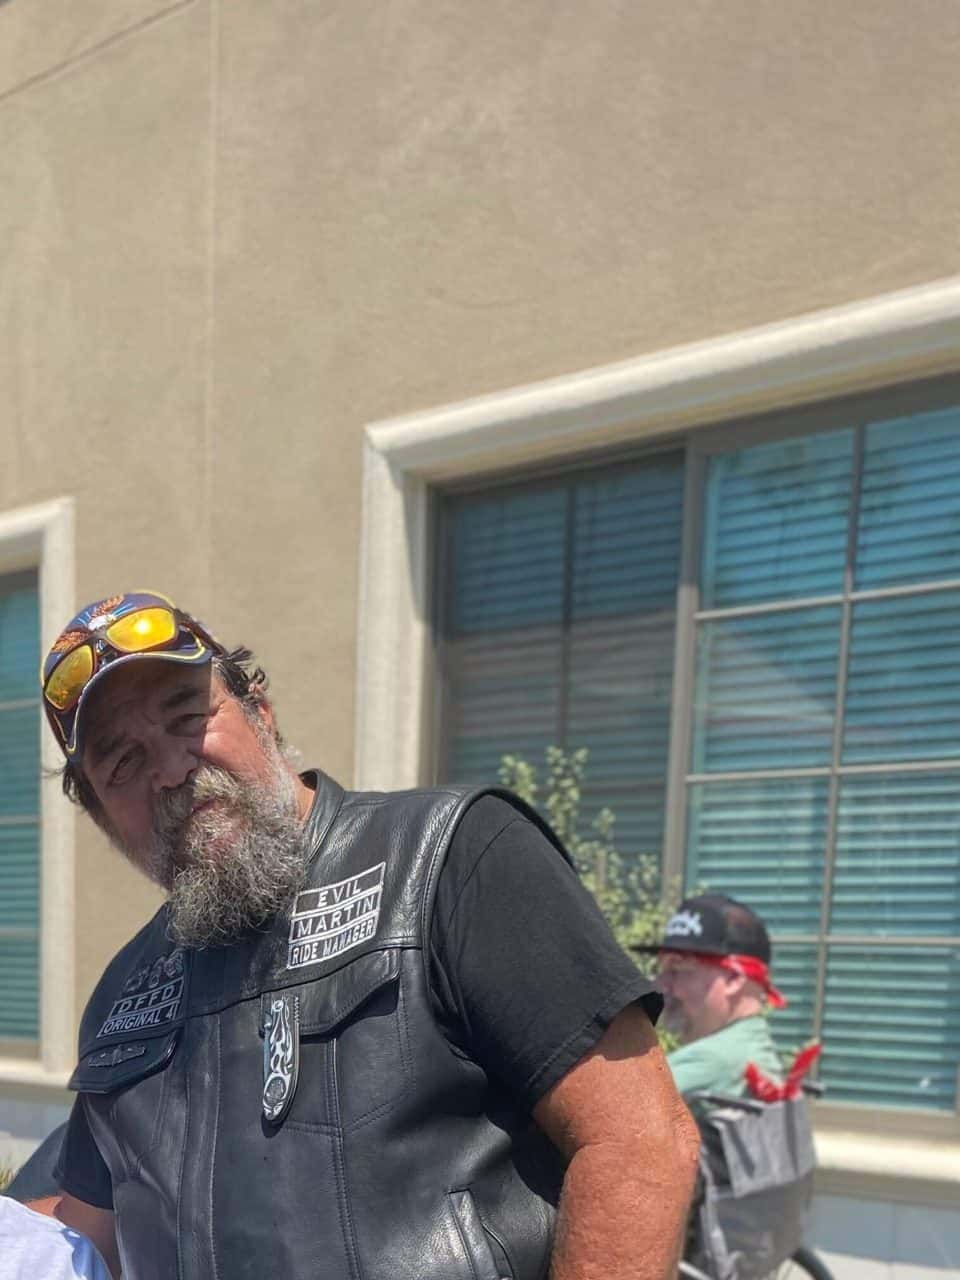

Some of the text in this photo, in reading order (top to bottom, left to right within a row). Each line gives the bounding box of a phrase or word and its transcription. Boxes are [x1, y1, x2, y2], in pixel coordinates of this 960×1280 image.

[317, 880, 361, 907] EVIL
[297, 895, 375, 938] MARTIN
[292, 919, 374, 965] RIDE MANAGER
[117, 985, 175, 1014] DFFD
[103, 1008, 161, 1034] ORIGINAL
